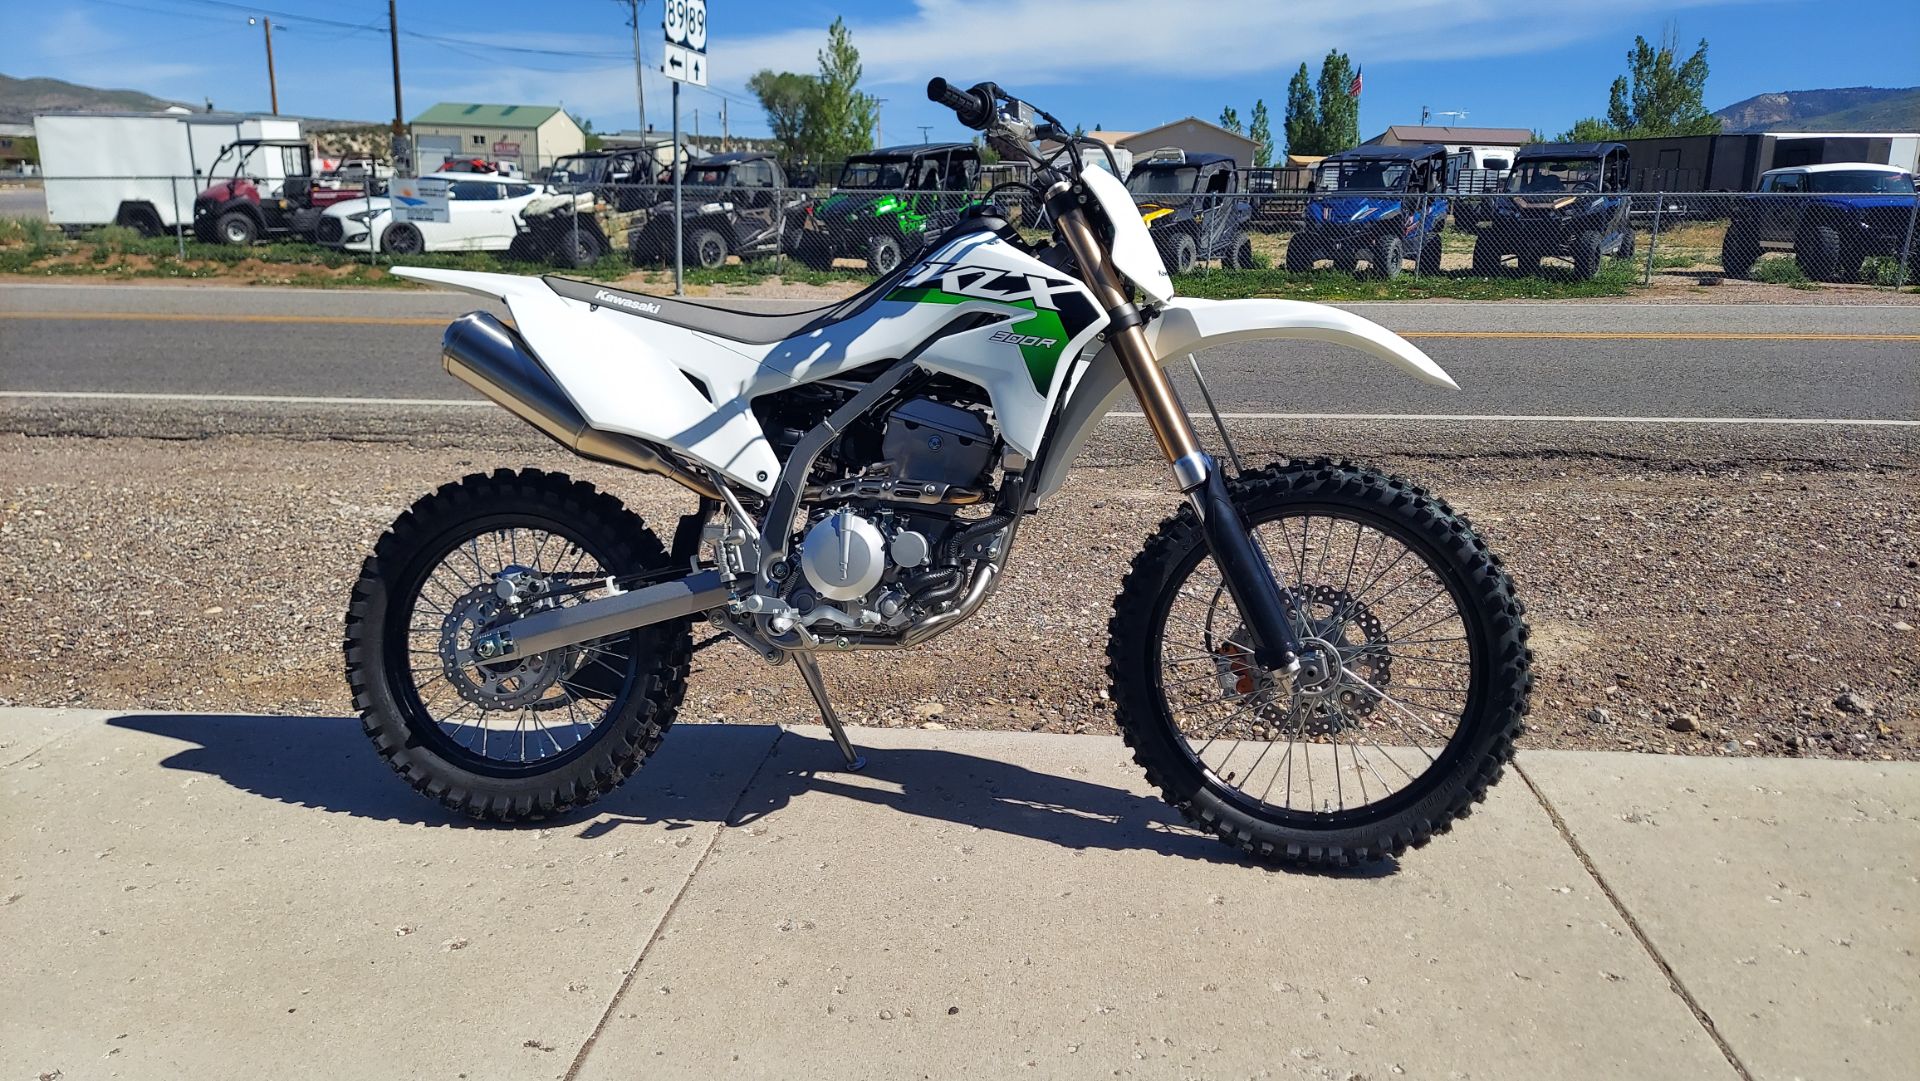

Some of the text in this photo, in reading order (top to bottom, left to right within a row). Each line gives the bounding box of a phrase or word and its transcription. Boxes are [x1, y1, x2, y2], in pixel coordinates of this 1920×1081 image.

[668, 0, 685, 29] 89
[689, 7, 705, 37] 89
[594, 289, 661, 314] Kawasaki
[989, 331, 1058, 349] 300R
